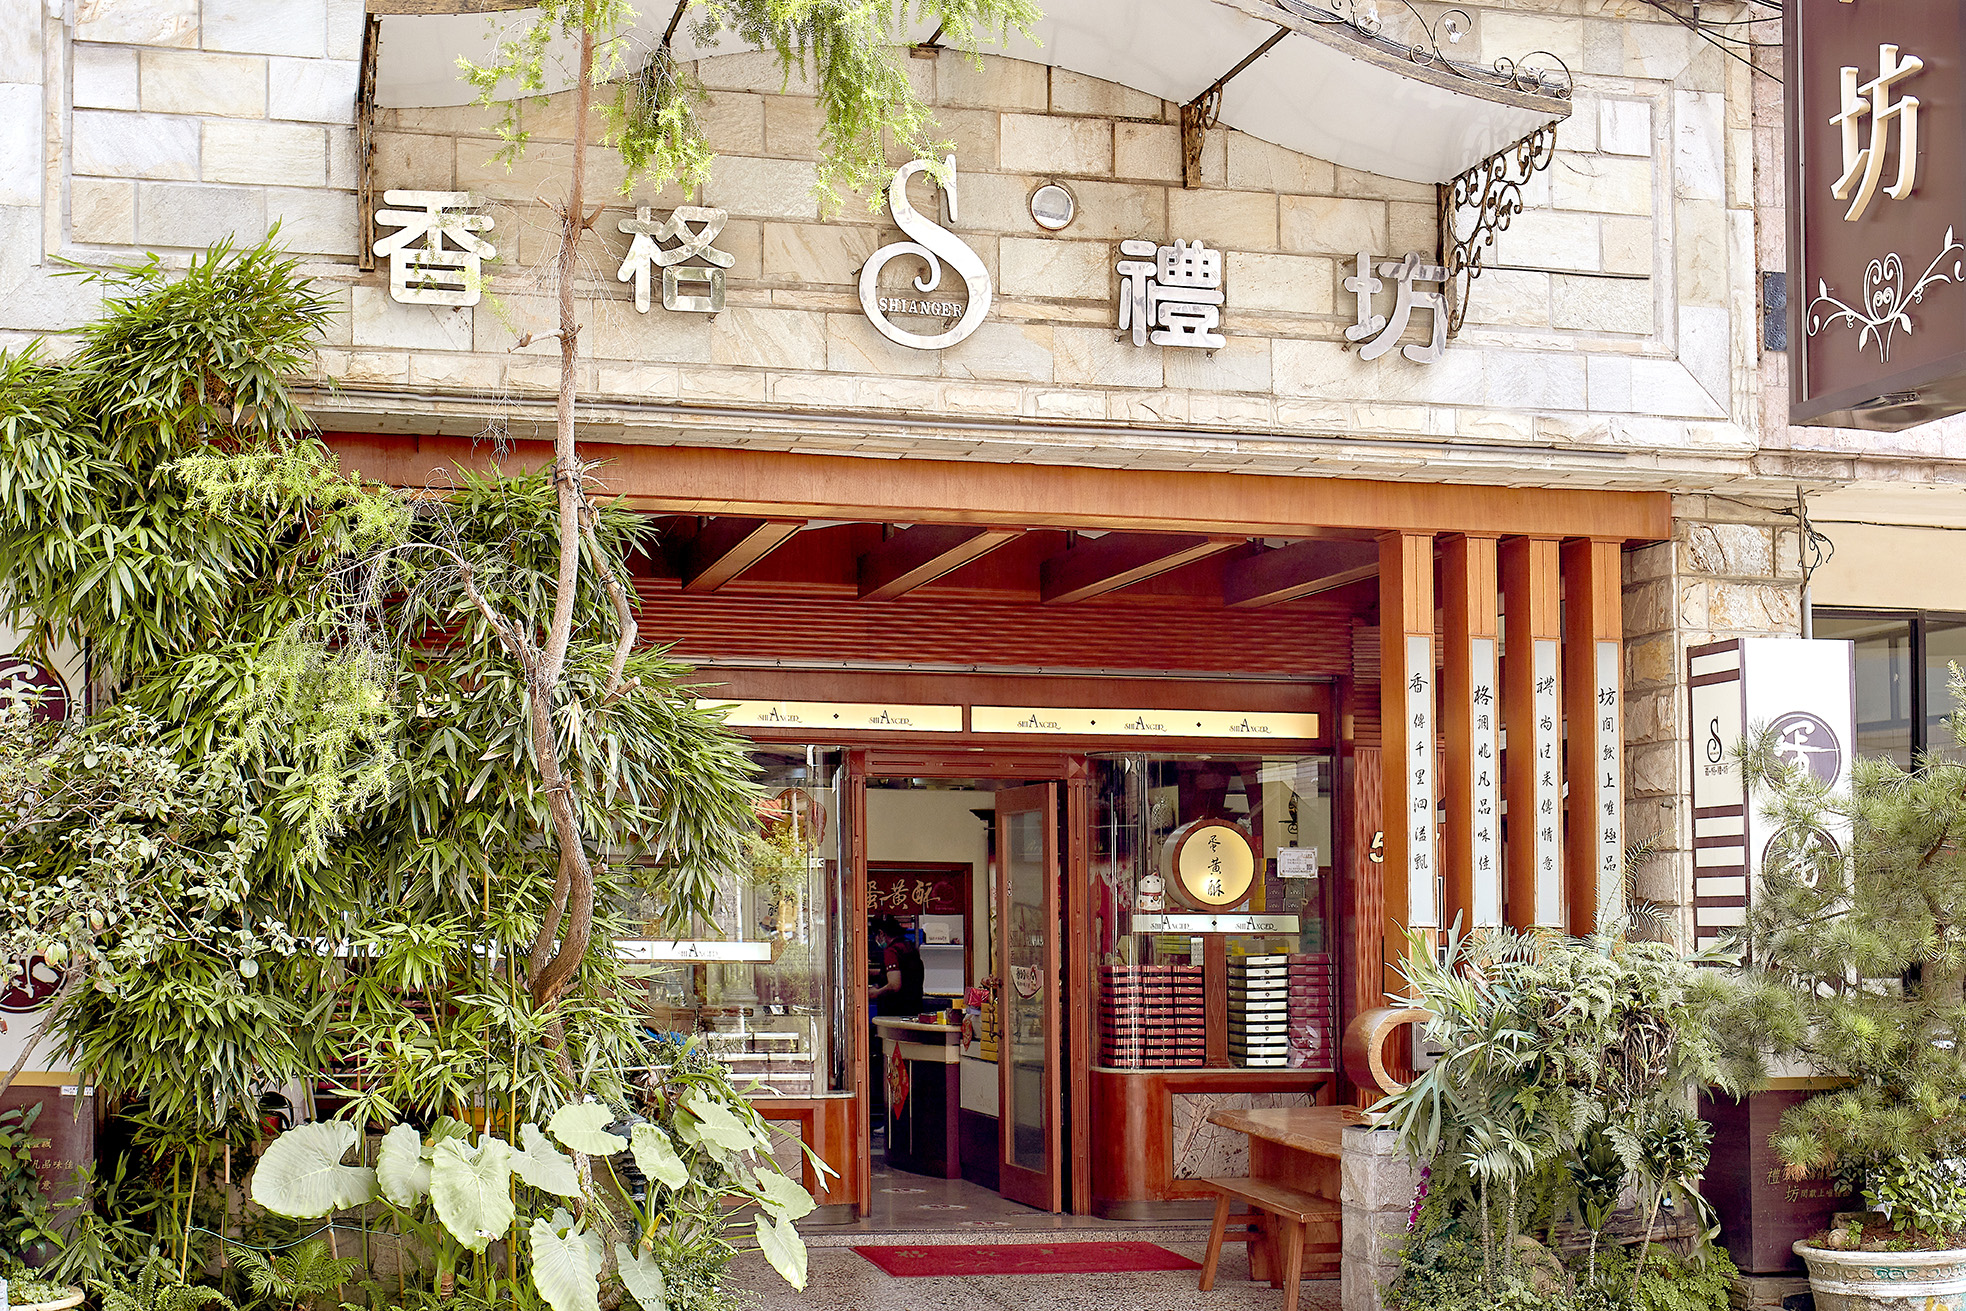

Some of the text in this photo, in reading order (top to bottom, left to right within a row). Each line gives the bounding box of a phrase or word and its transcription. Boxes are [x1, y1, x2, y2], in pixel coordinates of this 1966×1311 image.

[1829, 43, 1924, 222] 坊
[879, 297, 962, 318] SHIANGER
[1116, 238, 1450, 364] 禮坊
